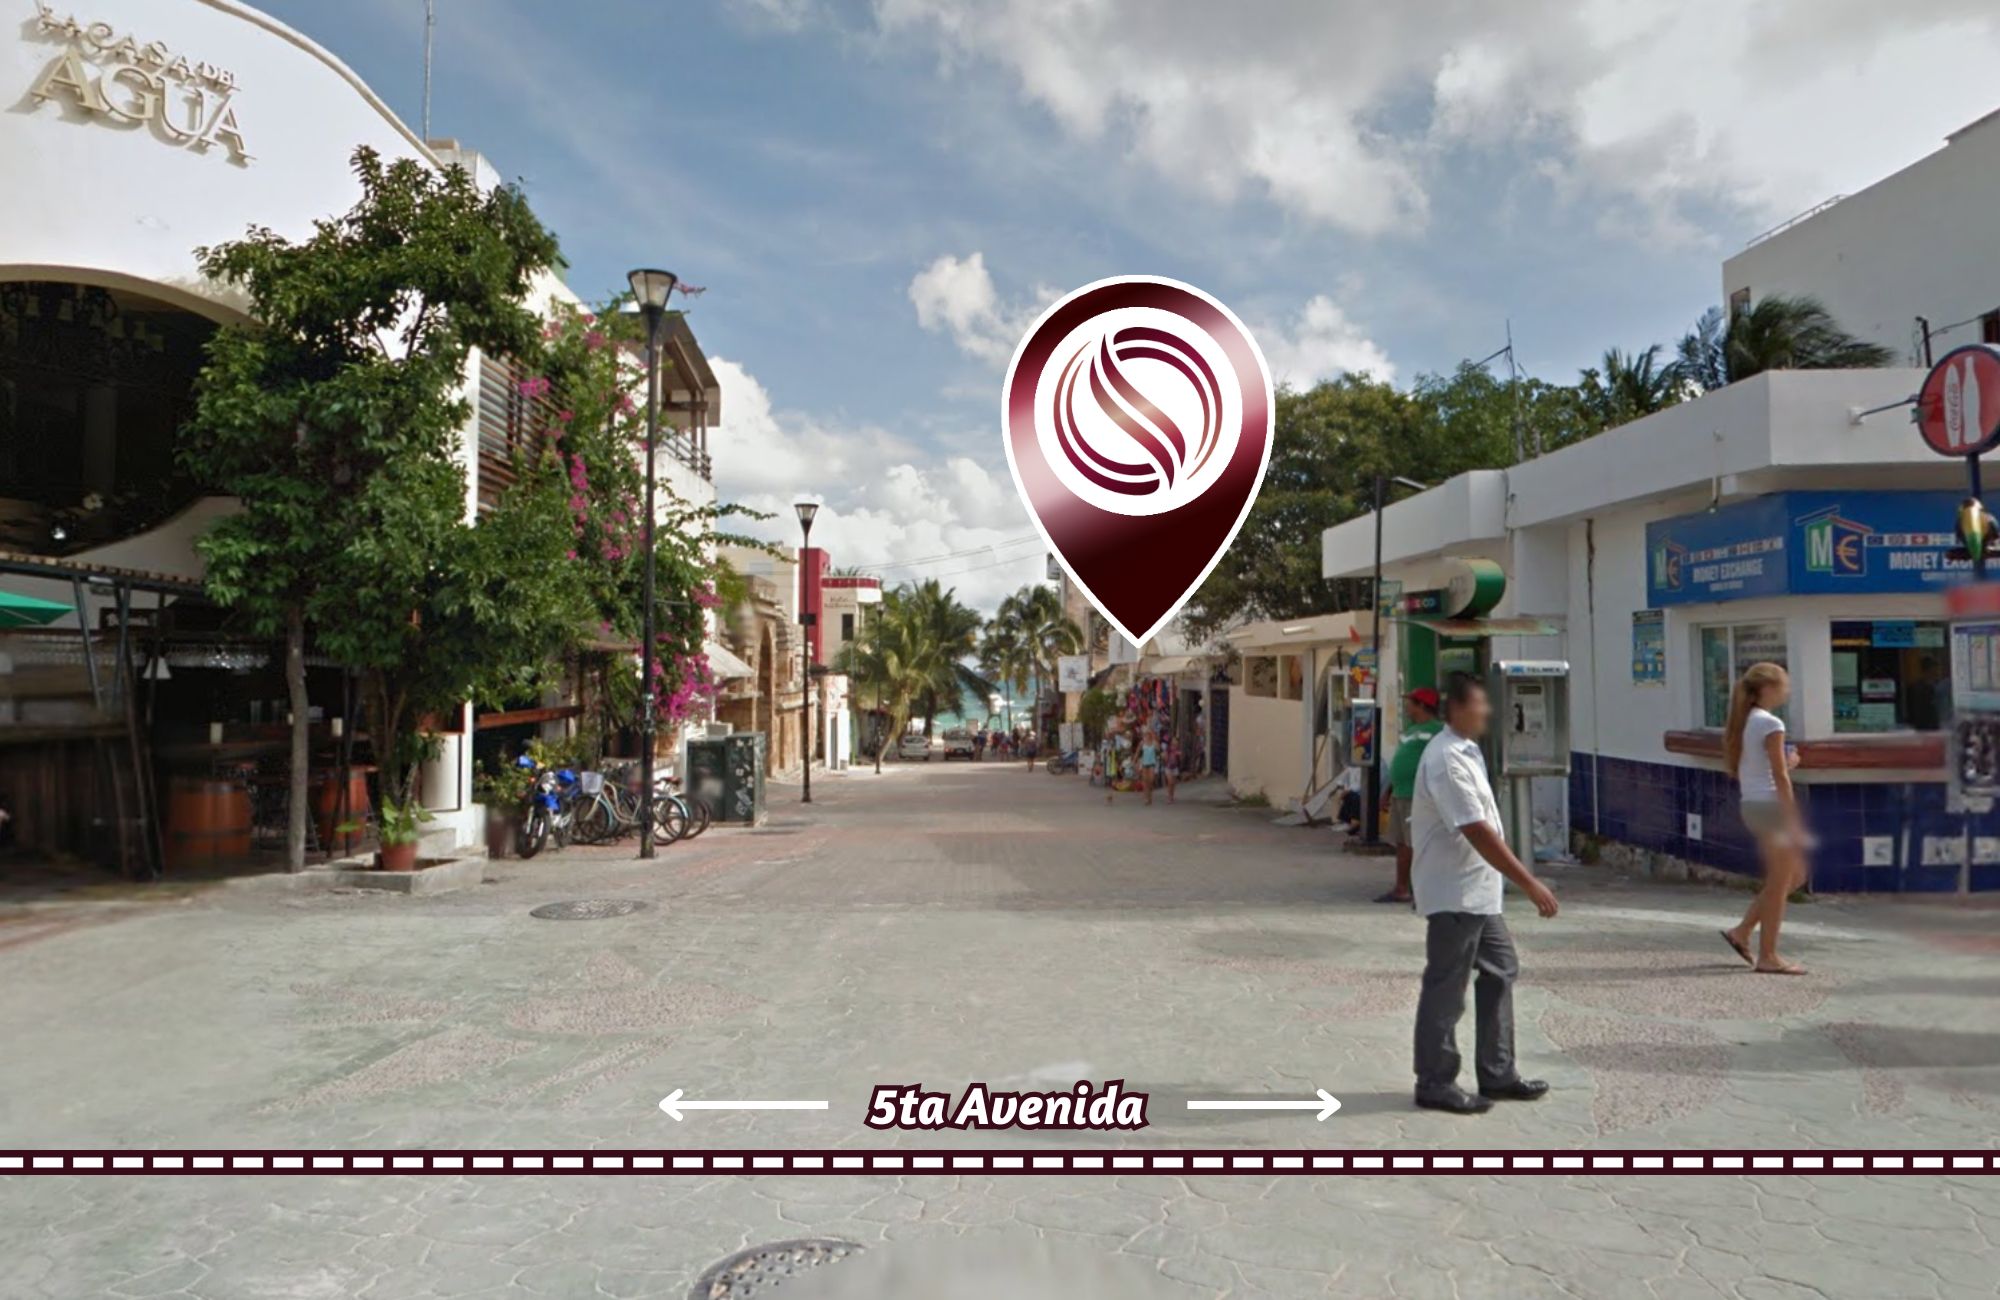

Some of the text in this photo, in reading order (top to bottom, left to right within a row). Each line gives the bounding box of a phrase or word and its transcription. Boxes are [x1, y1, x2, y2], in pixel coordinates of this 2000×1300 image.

[85, 22, 196, 78] CASA
[31, 51, 256, 161] AGUA
[1692, 563, 1719, 583] MONEY
[1889, 551, 1938, 570] MONEY
